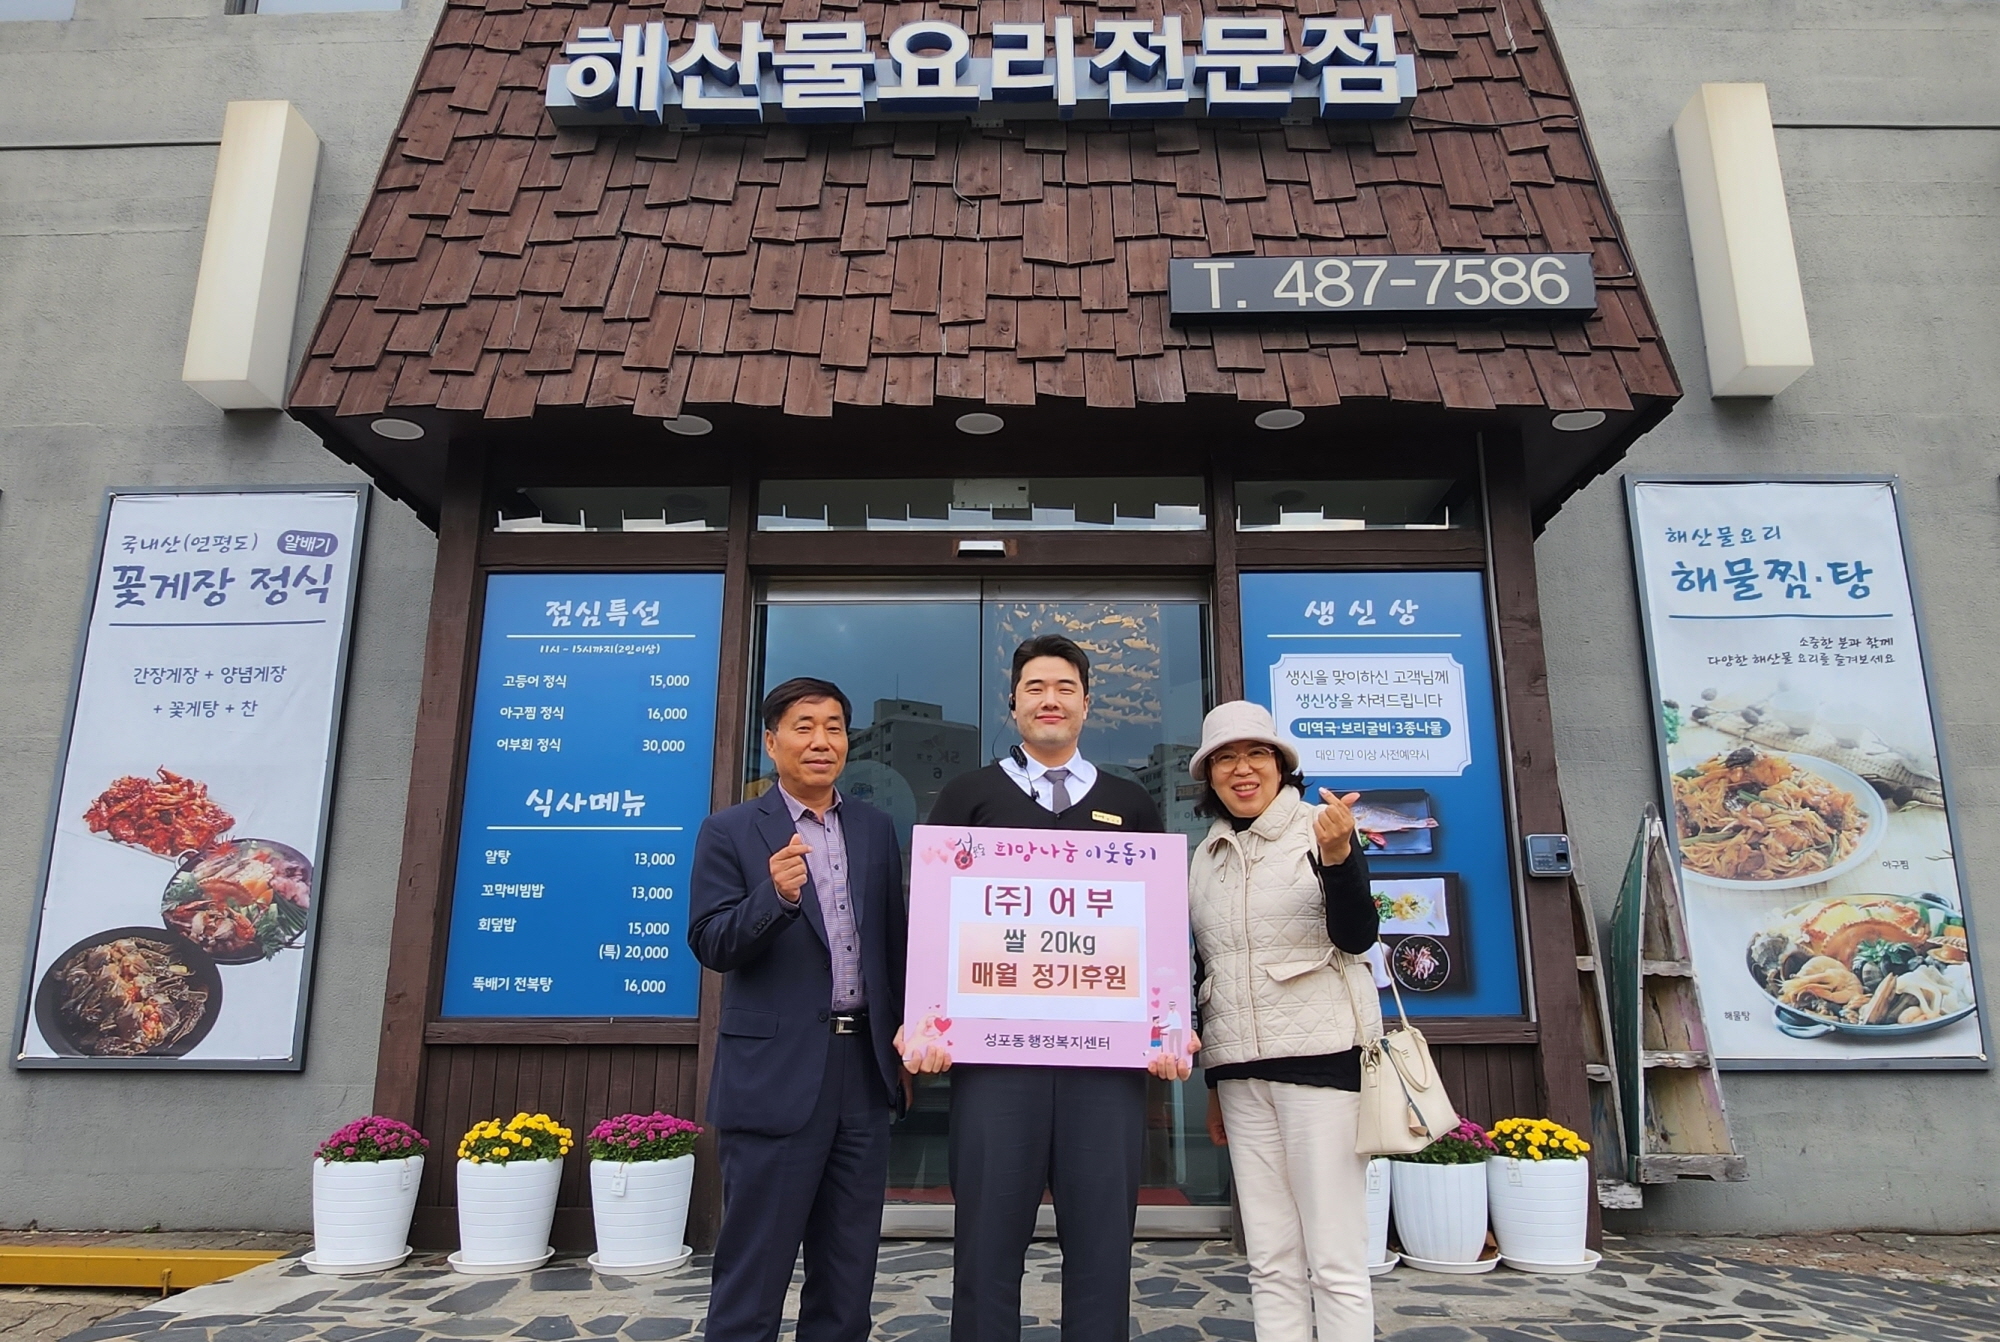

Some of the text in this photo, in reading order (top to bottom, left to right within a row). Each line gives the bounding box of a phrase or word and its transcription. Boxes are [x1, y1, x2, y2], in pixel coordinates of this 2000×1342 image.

[565, 14, 1402, 122] 해산물요리전문점
[1193, 256, 1570, 309] T. 487-7586
[121, 532, 259, 554] 국내산(연평도)
[283, 533, 331, 554] 알배기
[1665, 526, 1782, 547] 해산물요리
[112, 563, 333, 608] 꽃게장 정식
[545, 598, 661, 627] 점심특선
[1799, 635, 1894, 648] 소중한 분과 함께
[1707, 652, 1896, 667] 다양한 해산물 요리를 즐겨보세요
[133, 667, 199, 685] 간장게장
[220, 665, 287, 684] 양념게장
[502, 675, 690, 689] 고등어 정식 15,000
[1285, 669, 1450, 686] 생신을 맞이하신 고객님께
[169, 700, 219, 718] 꽃게탕
[240, 700, 258, 718] 찬
[1296, 692, 1443, 709] 생신상을 차려드립니다
[500, 706, 688, 722] 아구찜 정식 16,000
[497, 738, 685, 754] 어부회 정식 30,000
[1315, 749, 1430, 761] 대인 7인 이상 사전예약시
[525, 788, 646, 818] 식사메뉴
[485, 850, 675, 867] 알탕 13,000
[994, 839, 1079, 864] 희망나눔
[1085, 841, 1157, 866] 이웃돕기
[1882, 860, 1909, 870] 아구찜
[481, 883, 673, 901] 꼬막비빔밥 13,000
[478, 917, 670, 937] 회덮밥 15,000
[599, 943, 669, 961] (특) 20,000
[1003, 929, 1096, 956] 쌀 20kg
[971, 961, 1127, 990] 매월 정기후원
[472, 976, 666, 995] 뚝배기 전복탕 16,000
